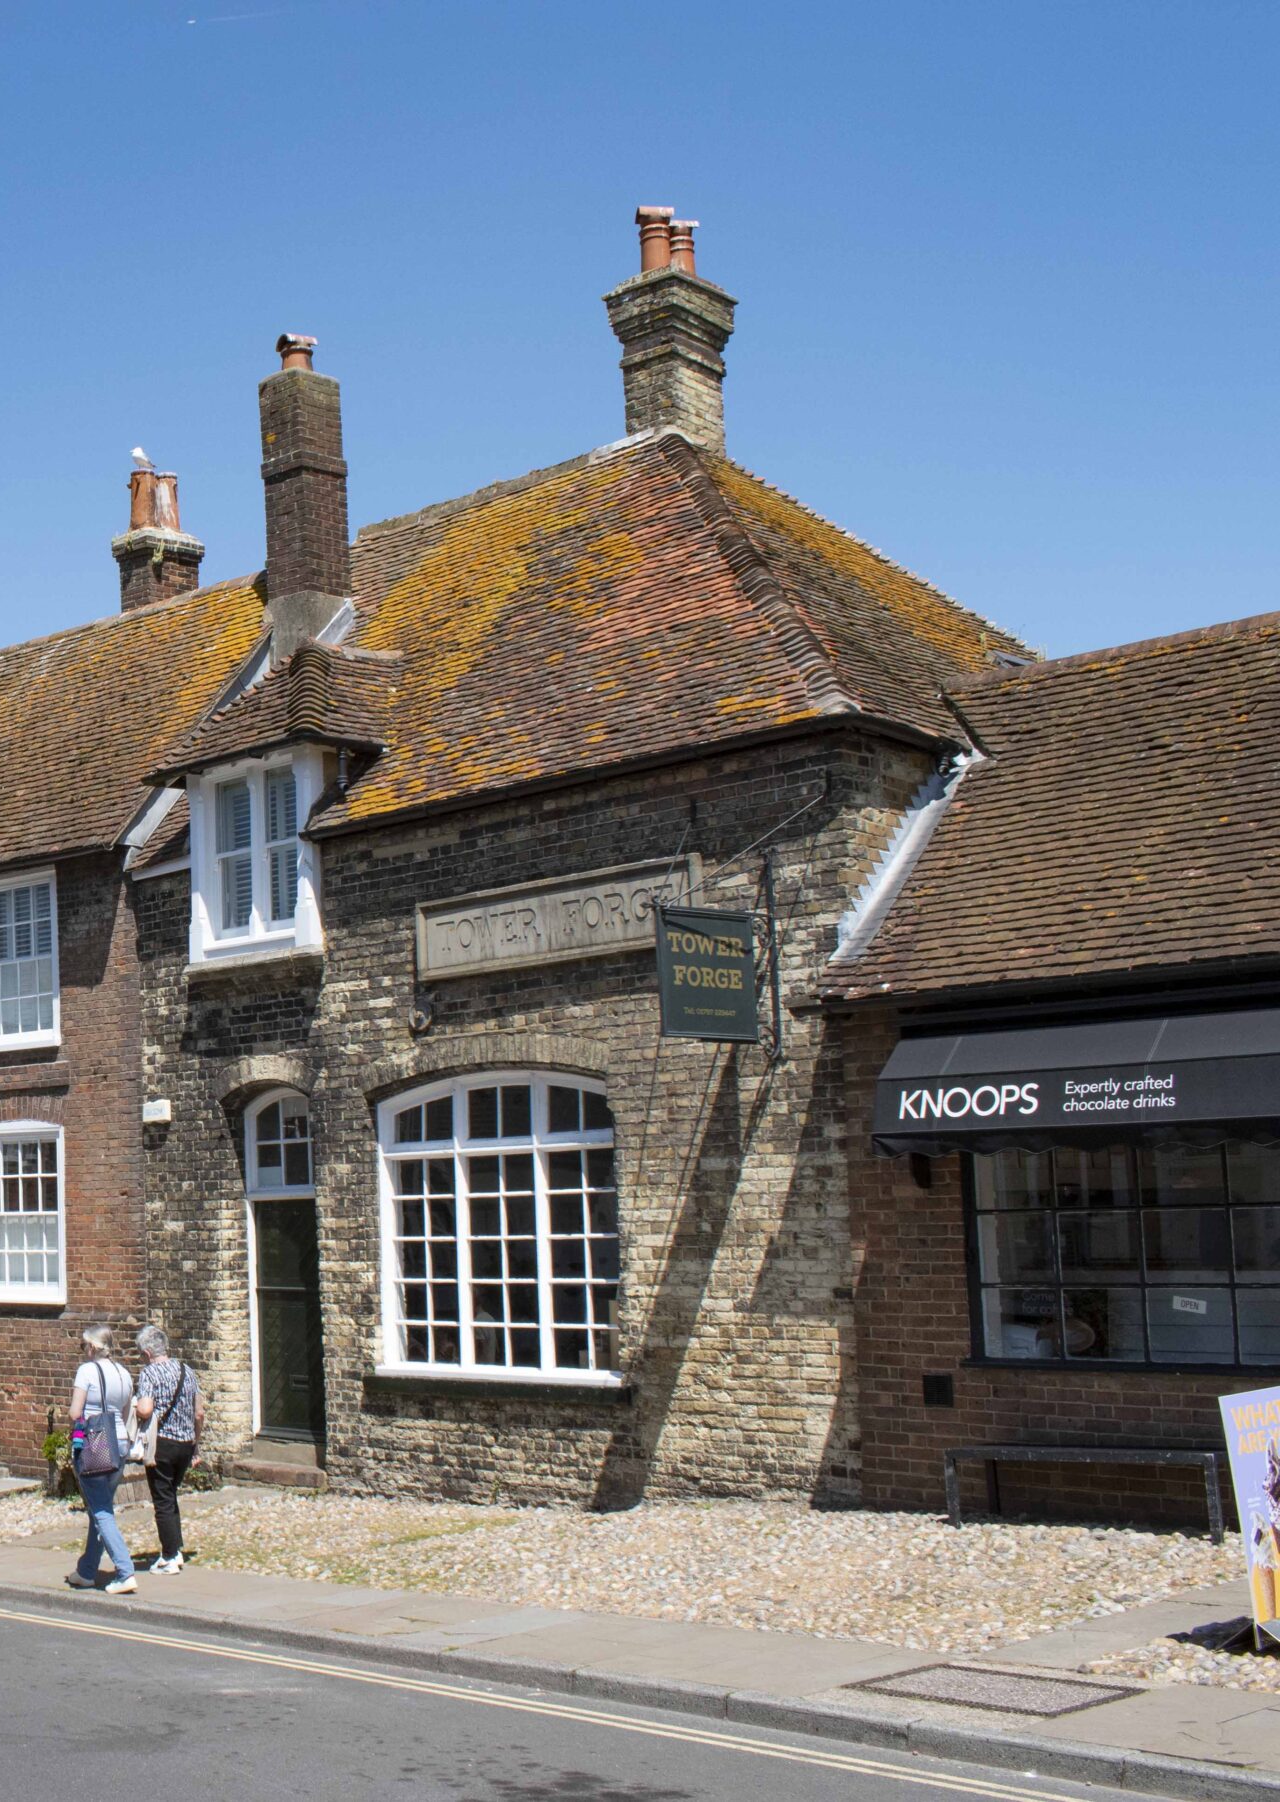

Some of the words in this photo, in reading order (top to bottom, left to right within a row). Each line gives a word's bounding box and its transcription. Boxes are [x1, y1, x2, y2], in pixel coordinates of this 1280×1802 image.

[436, 907, 541, 951] TOWER
[667, 931, 745, 958] TOWER
[672, 965, 743, 990] FORGE
[1064, 1078, 1121, 1098] Expertly
[1123, 1074, 1174, 1091] crafted
[898, 1082, 1040, 1119] KNOOPS
[1063, 1096, 1130, 1112] chocolate
[1133, 1093, 1176, 1108] drinks
[1181, 1299, 1199, 1310] OPEN
[1237, 1430, 1267, 1455] ARE
